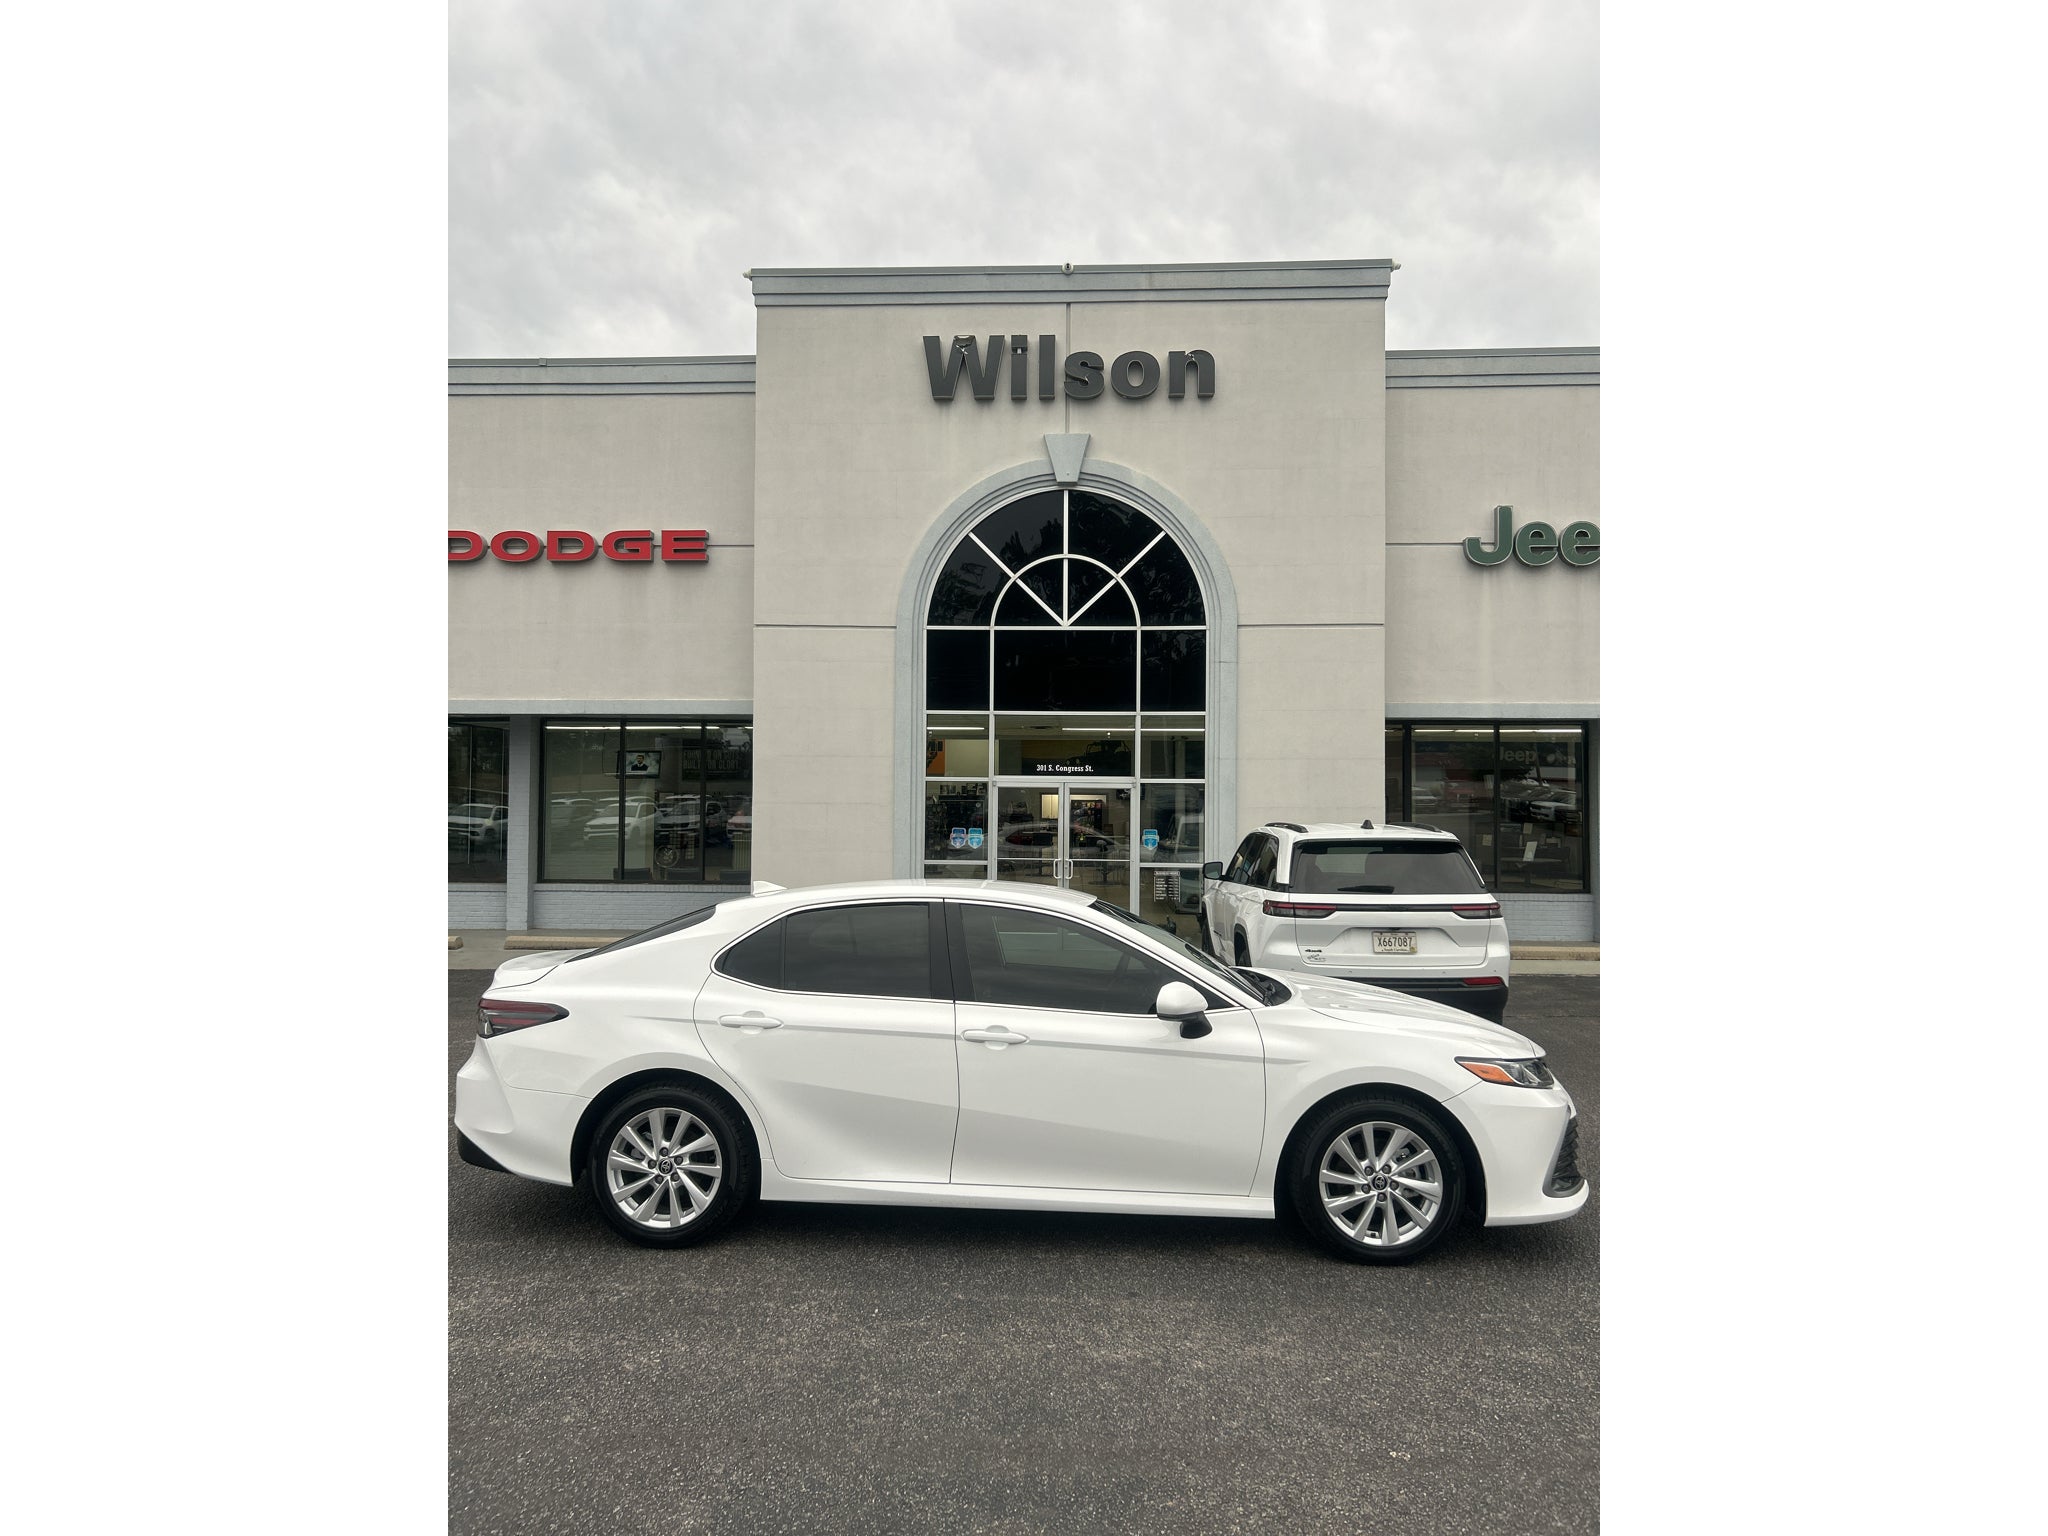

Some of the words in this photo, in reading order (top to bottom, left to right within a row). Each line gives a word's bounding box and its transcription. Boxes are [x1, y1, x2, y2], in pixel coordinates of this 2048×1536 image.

[922, 334, 1216, 401] Wilson
[448, 529, 709, 564] DODGE
[1036, 764, 1047, 772] 301
[1048, 764, 1054, 772] S.
[1055, 764, 1084, 773] Congress
[1085, 764, 1094, 772] St.
[1377, 936, 1412, 947] X667087
